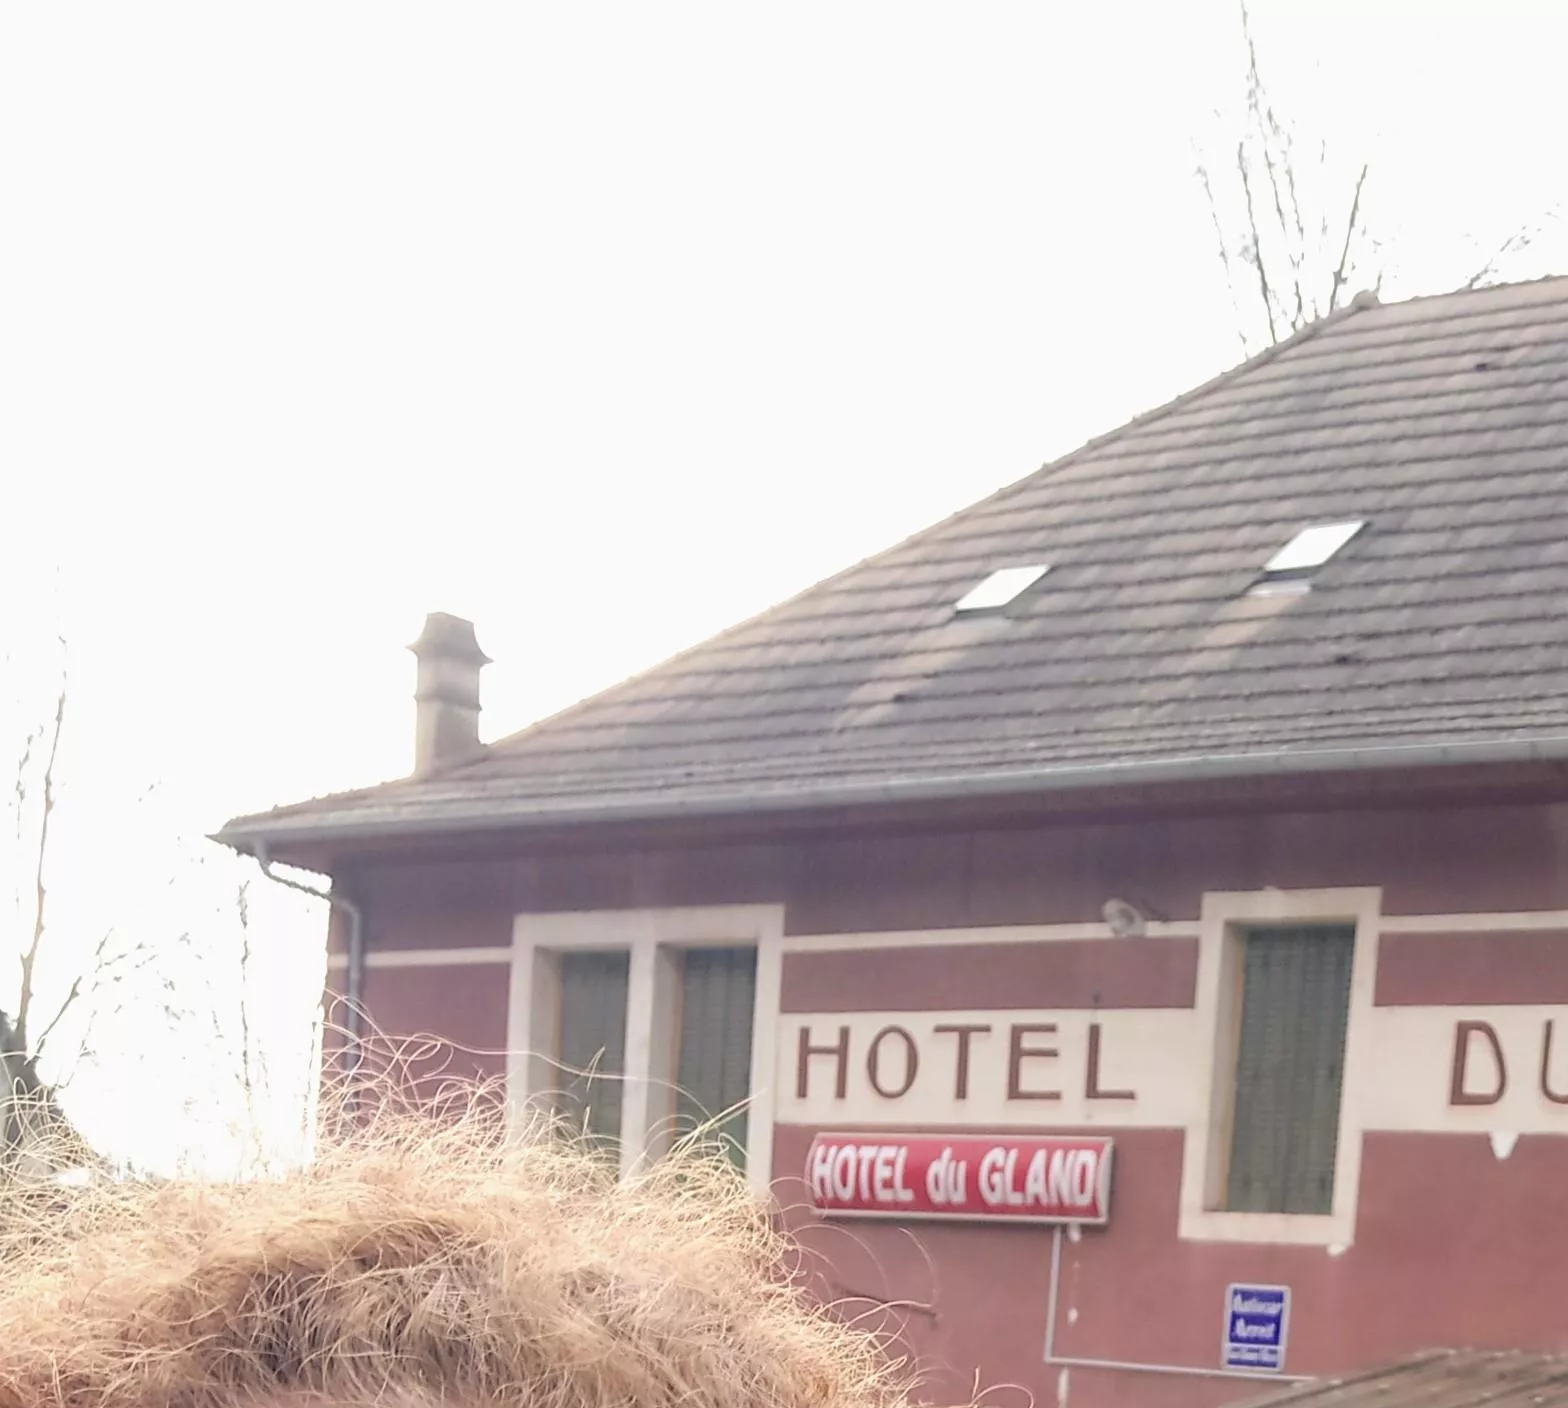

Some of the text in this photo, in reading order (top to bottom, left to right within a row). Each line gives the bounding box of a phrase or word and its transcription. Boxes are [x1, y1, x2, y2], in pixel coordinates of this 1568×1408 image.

[796, 1023, 1136, 1101] HOTEL
[811, 1144, 1098, 1206] HOTEL du GLAND
